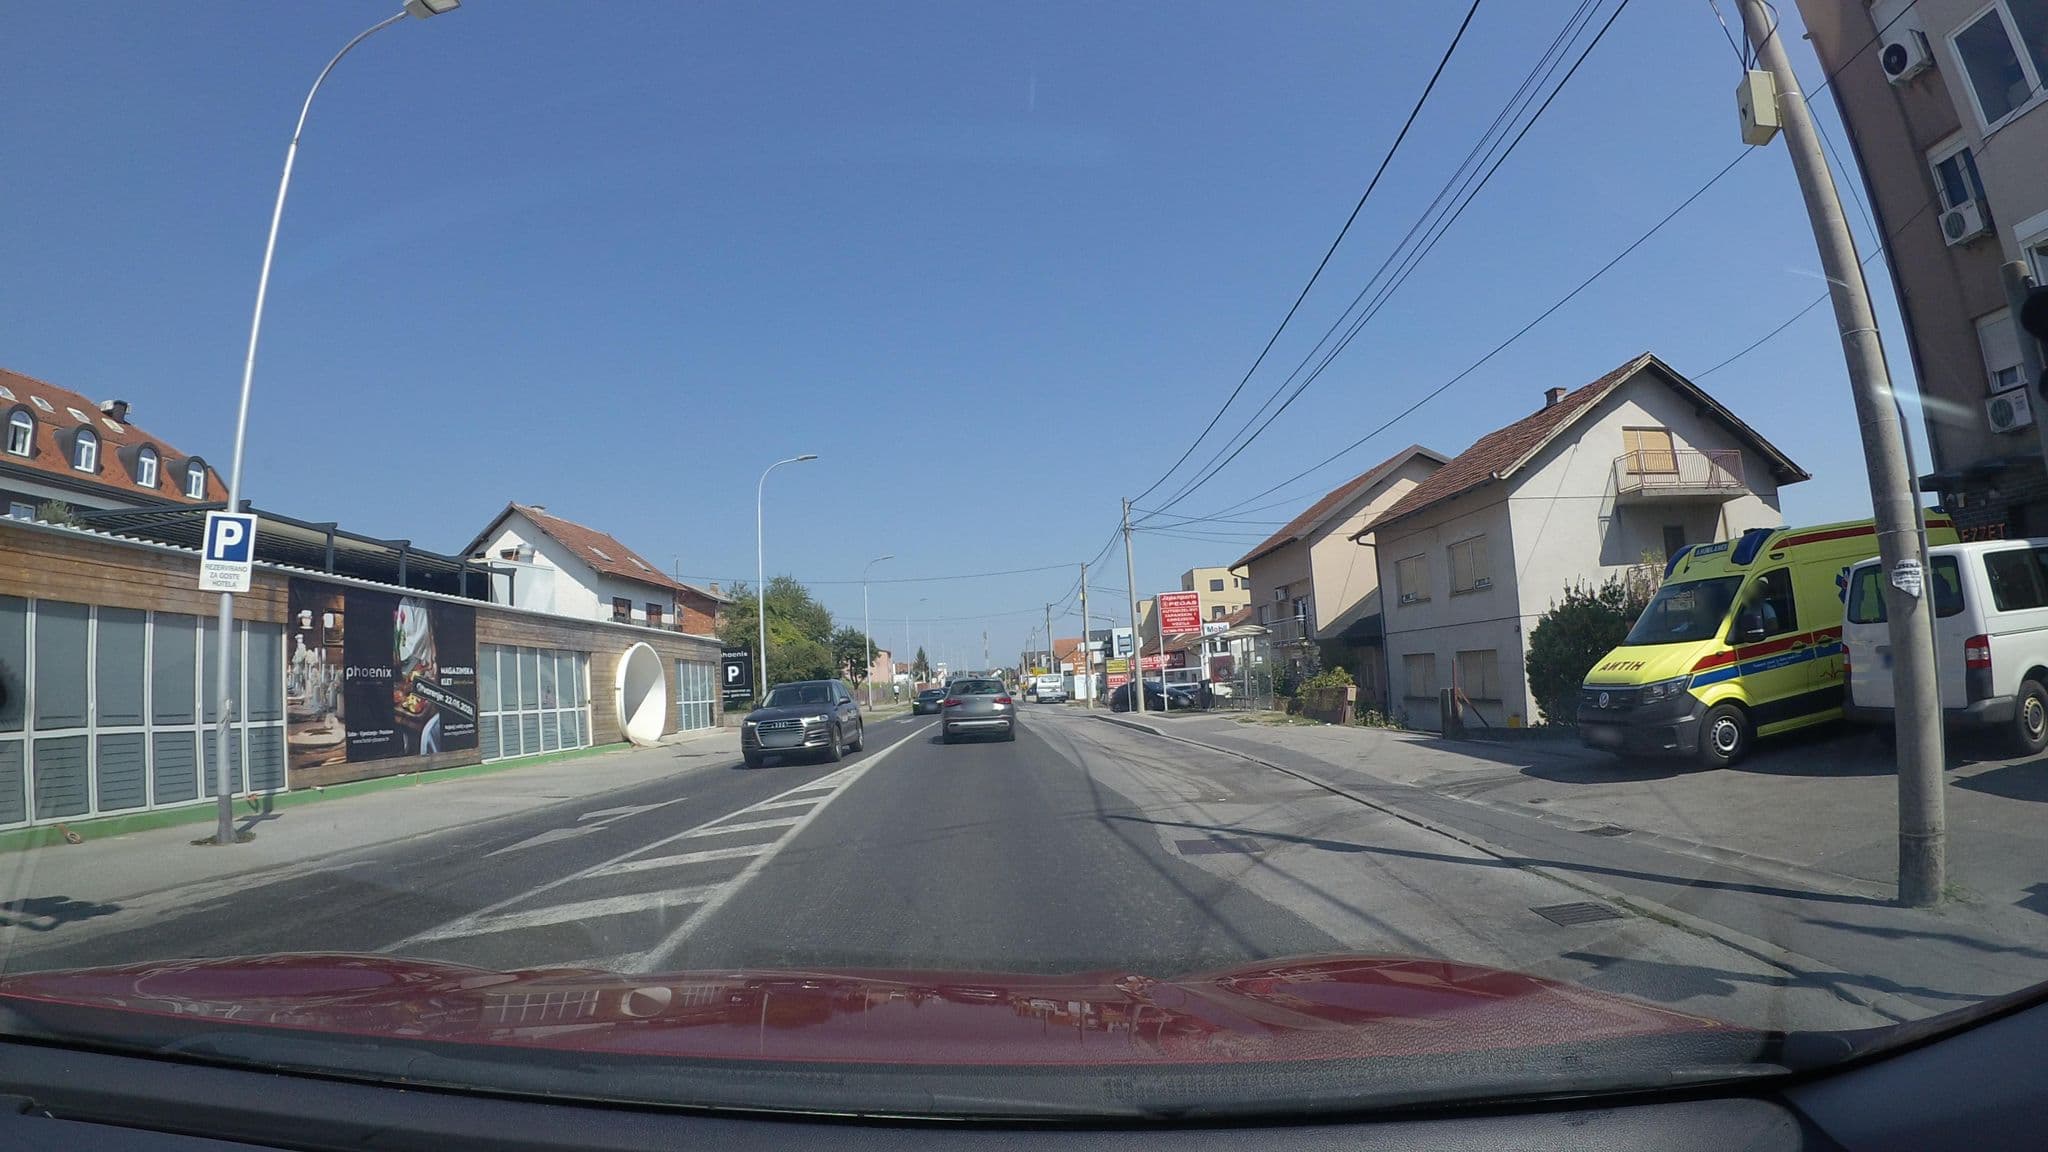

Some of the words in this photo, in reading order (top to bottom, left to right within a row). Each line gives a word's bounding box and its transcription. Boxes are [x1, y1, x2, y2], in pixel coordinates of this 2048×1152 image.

[214, 520, 243, 558] P
[205, 564, 248, 572] REZERVIRANO
[346, 665, 392, 680] phoenix
[728, 666, 739, 682] P
